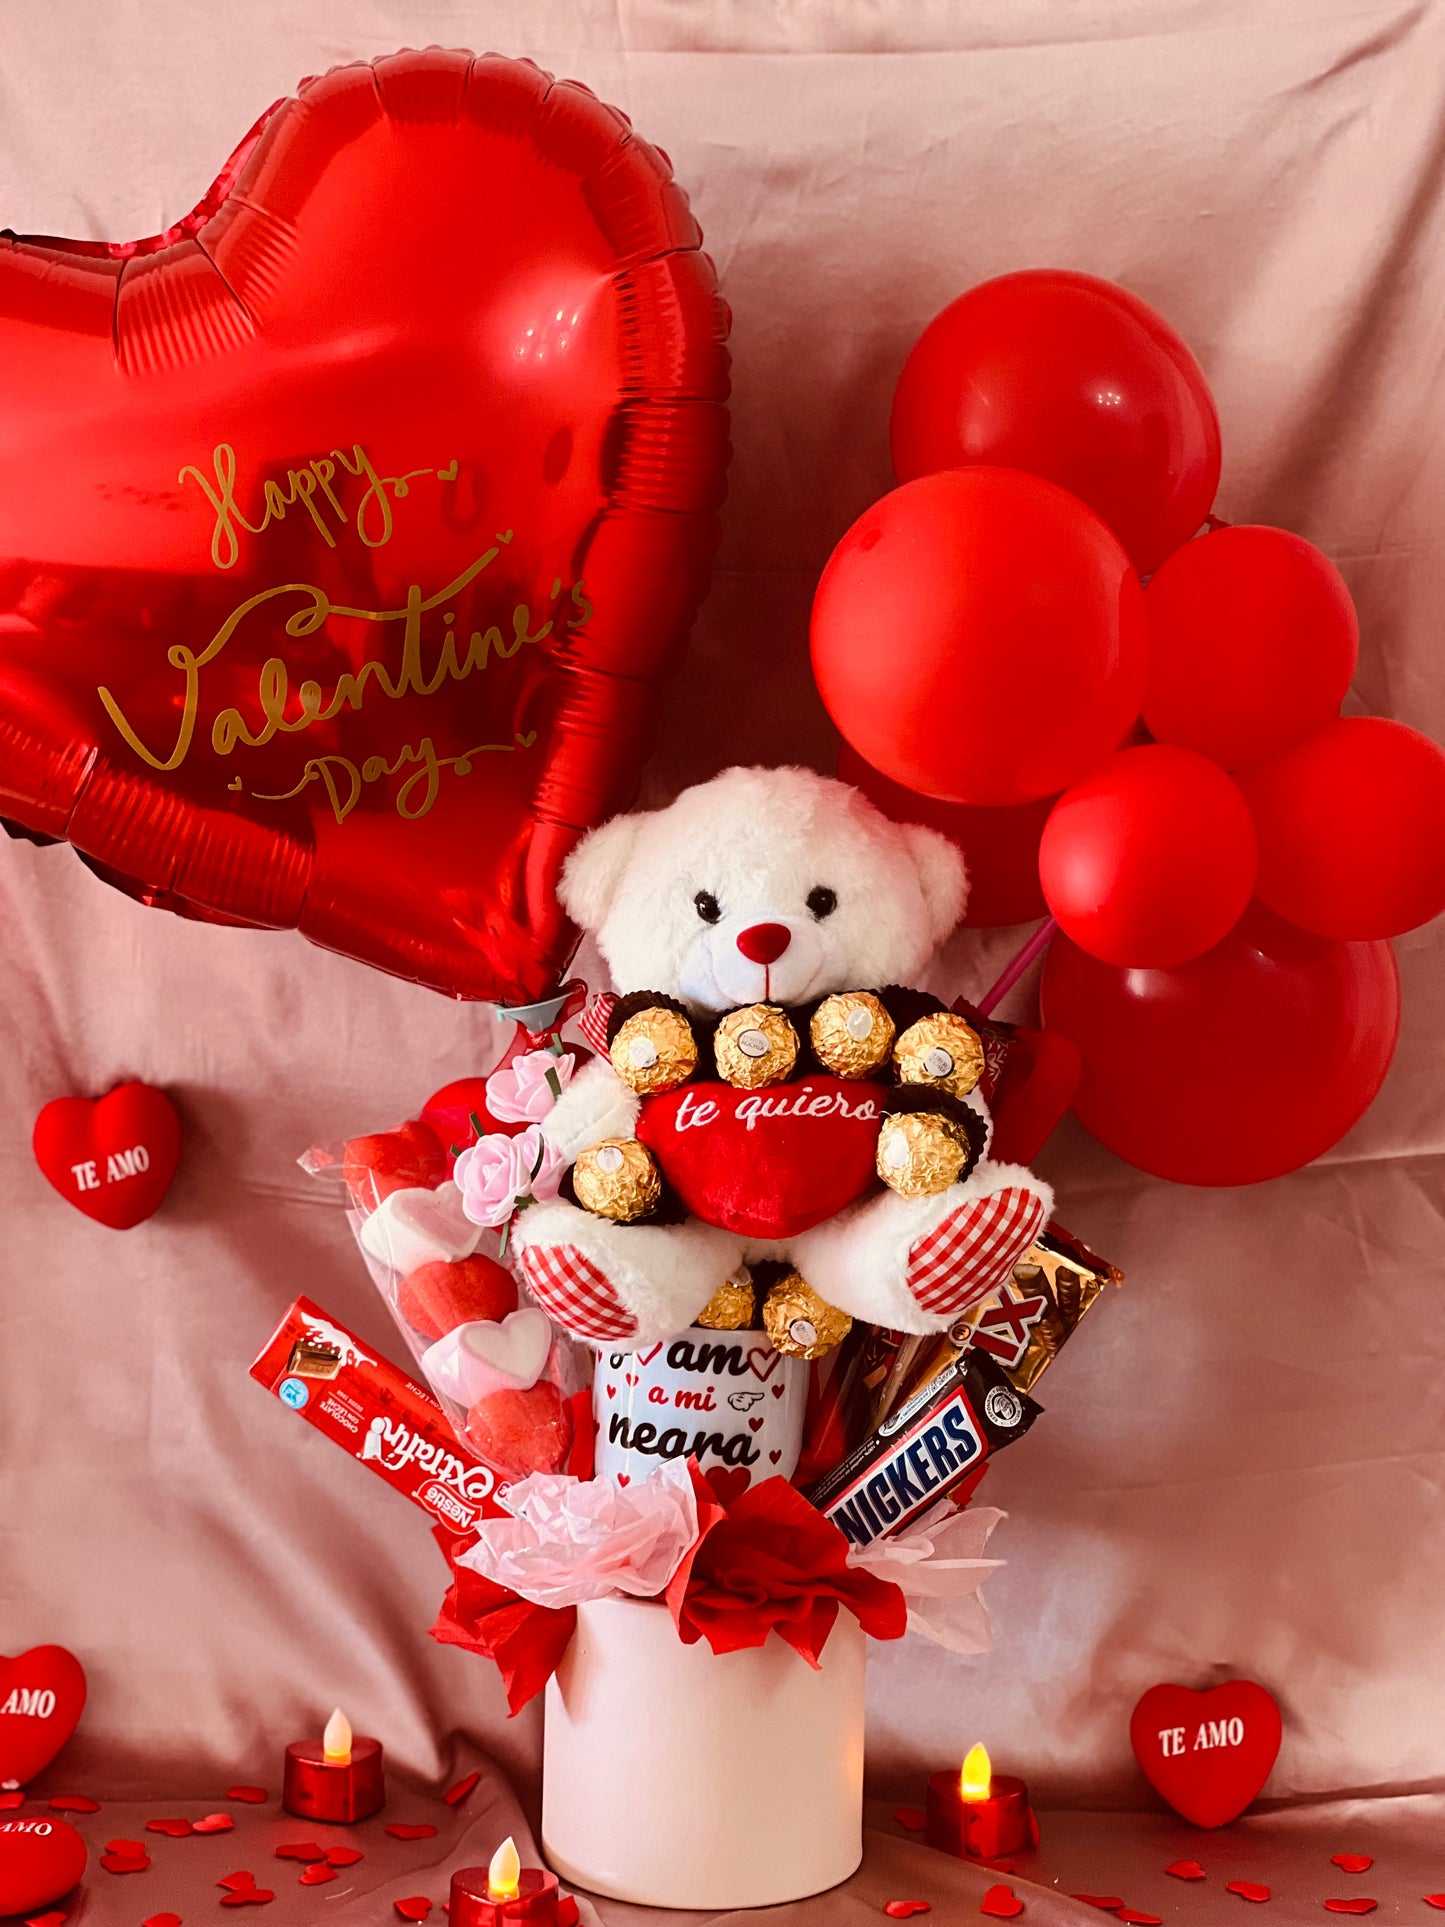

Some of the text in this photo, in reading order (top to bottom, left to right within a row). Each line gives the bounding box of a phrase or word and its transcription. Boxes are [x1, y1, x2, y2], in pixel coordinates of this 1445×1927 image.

[179, 443, 433, 569] Happy
[98, 547, 594, 771] Valentine's
[251, 737, 515, 825] Day
[675, 1087, 879, 1132] te quiero
[71, 1145, 150, 1191] TE AMO
[320, 1401, 359, 1433] CHOCOLATE
[325, 1397, 348, 1416] LECHE
[648, 1386, 717, 1412] a mi
[829, 1404, 977, 1547] NICKERS
[0, 1688, 56, 1718] AMO
[1158, 1716, 1245, 1757] TE AMO
[0, 1821, 53, 1836] AMO
